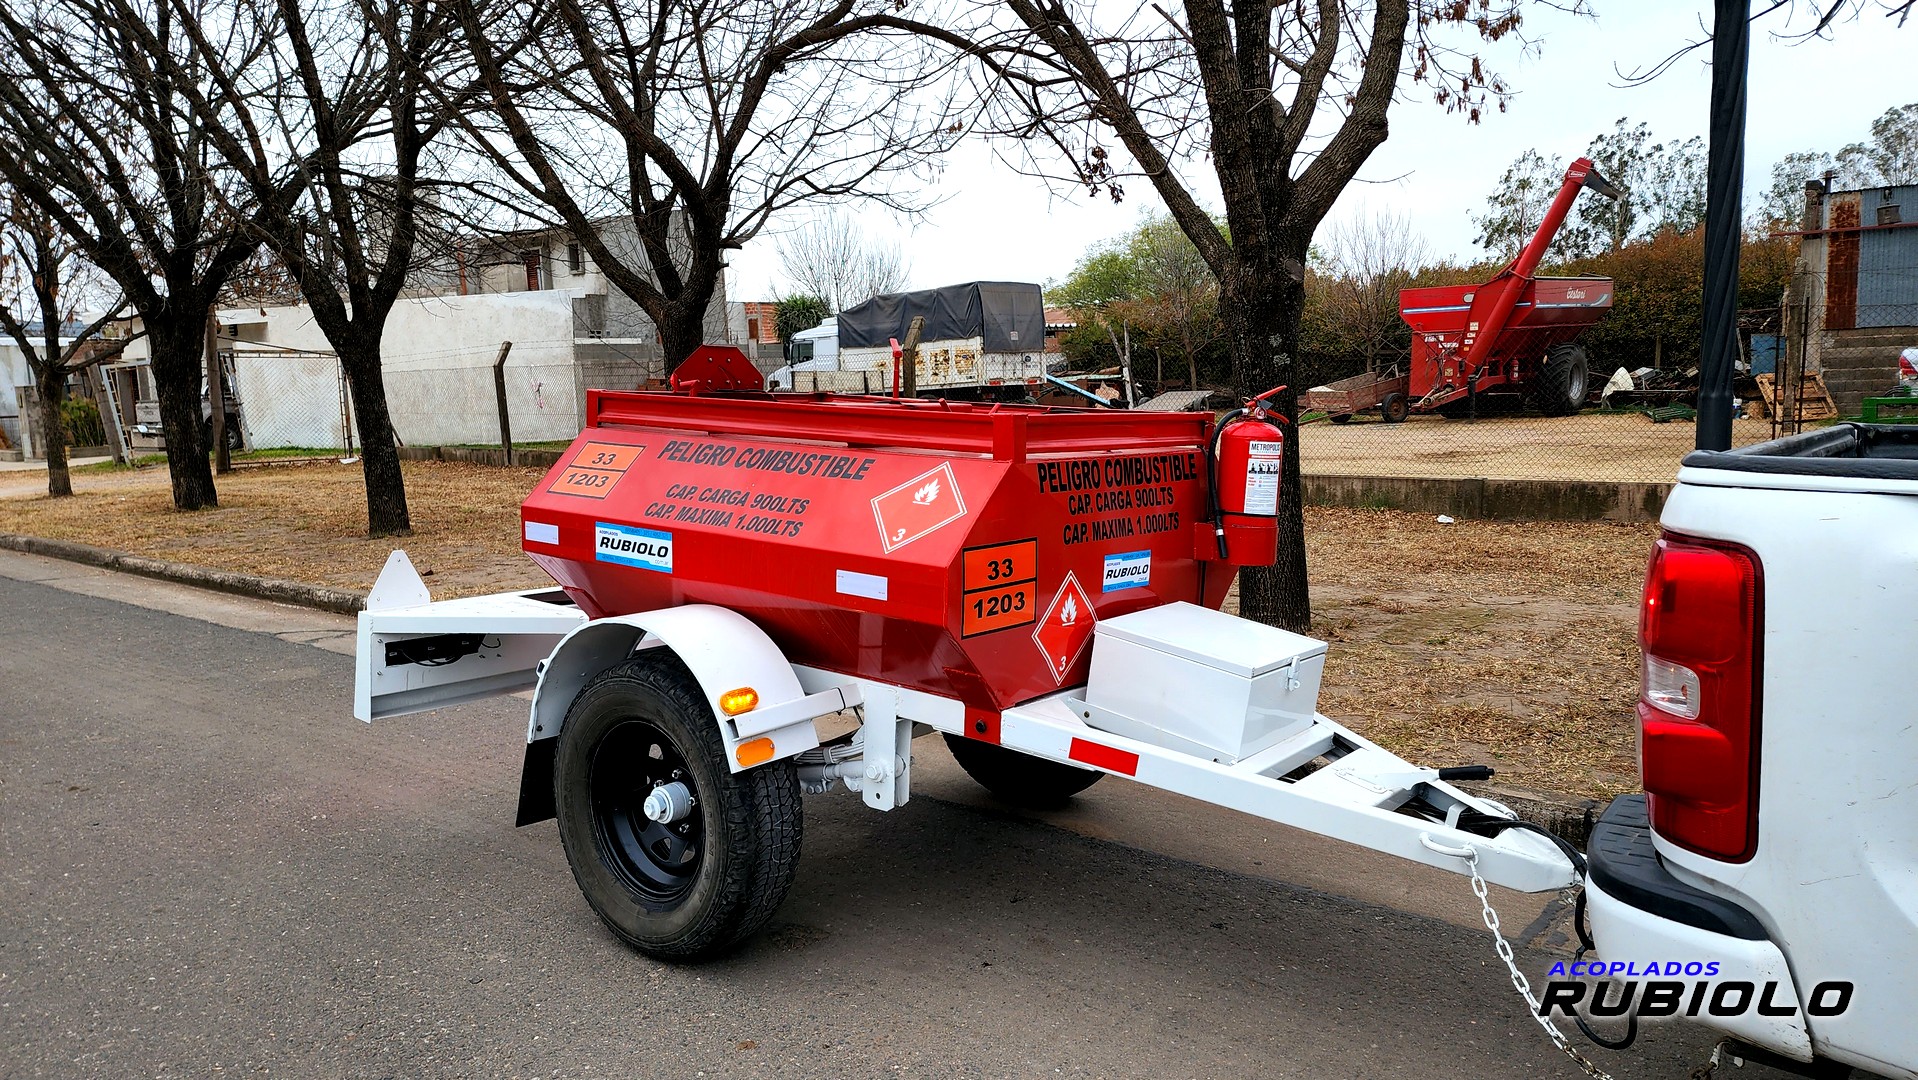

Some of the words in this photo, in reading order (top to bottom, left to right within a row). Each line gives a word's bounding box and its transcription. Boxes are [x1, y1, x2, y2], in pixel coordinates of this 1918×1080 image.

[591, 452, 616, 465] 33
[657, 440, 736, 466] PELIGRO
[734, 448, 875, 480] COMBUSTIBLE
[566, 472, 609, 487] 1203
[1037, 460, 1100, 493] PELIGRO
[1104, 454, 1197, 488] COMBUSTIBLE
[665, 484, 698, 499] CAP.
[698, 487, 750, 507] CARGA
[750, 493, 810, 515] 900LTS
[1068, 494, 1093, 515] CAP.
[1095, 489, 1133, 513] CARGA
[1135, 486, 1174, 508] 900LTS
[644, 502, 676, 519] CAP.
[674, 506, 734, 529] MAXIMA
[734, 514, 803, 537] 1.000LTS
[1063, 523, 1089, 545] CAP.
[1092, 517, 1134, 541] MAXIMA
[1136, 512, 1179, 535] 1.000LTS
[892, 528, 906, 541] 3
[599, 536, 669, 558] RUBIOLO
[987, 558, 1014, 580] 33
[1105, 564, 1149, 580] RUBIOLO
[973, 591, 1026, 618] 1203
[1059, 655, 1067, 671] 3
